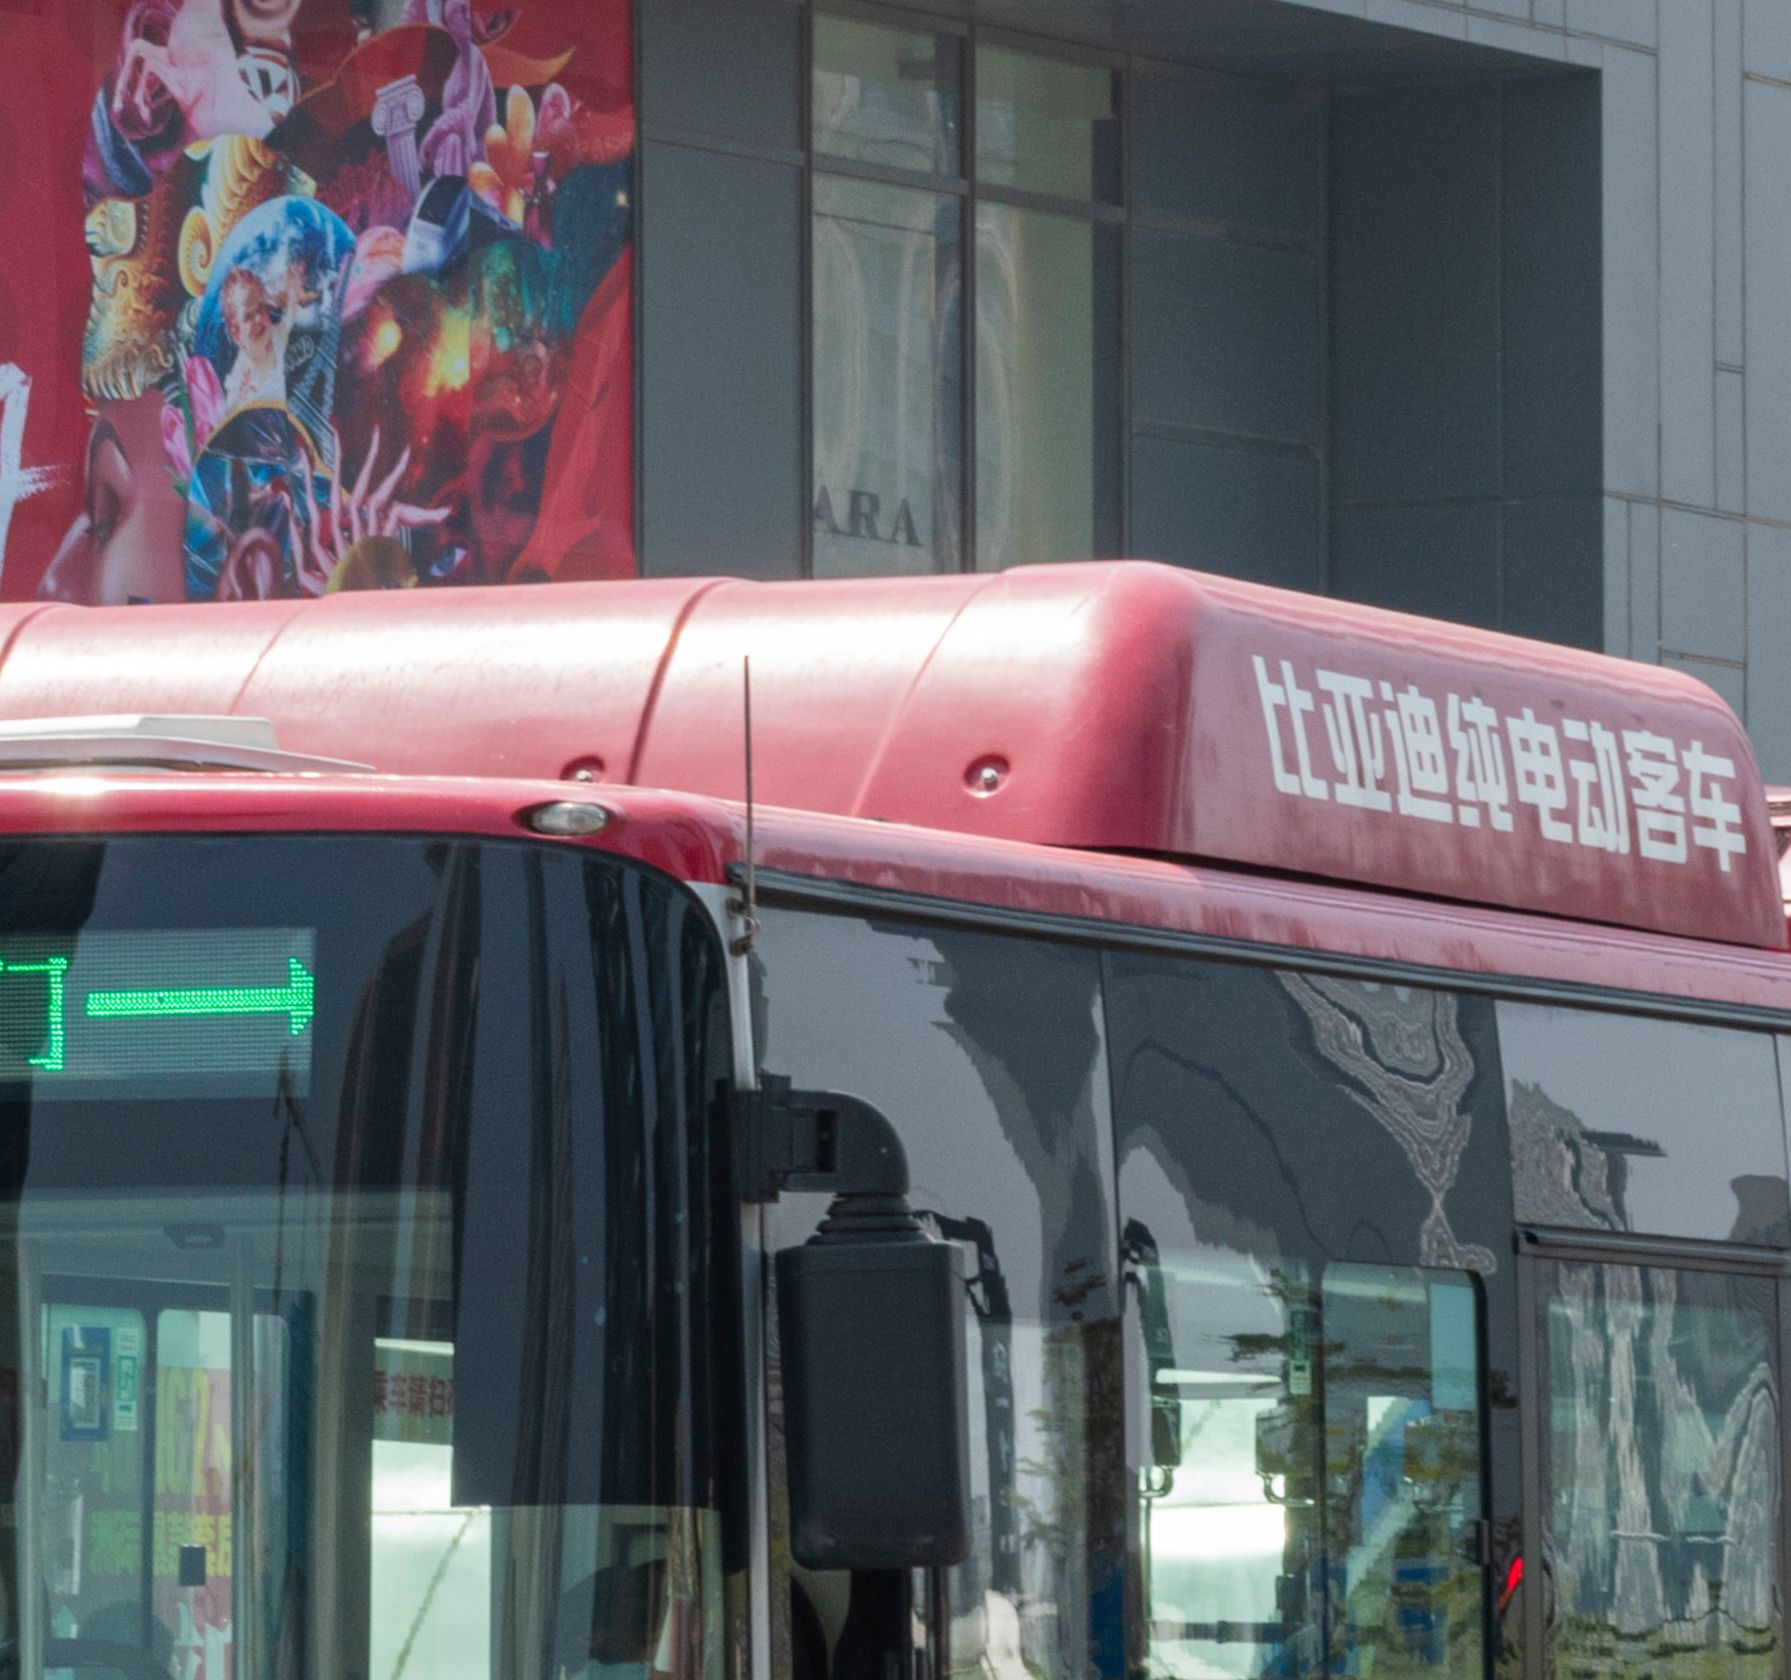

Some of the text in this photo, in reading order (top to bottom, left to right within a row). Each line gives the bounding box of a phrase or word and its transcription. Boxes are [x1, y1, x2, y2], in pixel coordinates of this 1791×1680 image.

[1252, 655, 1746, 872] 比亚迪纯电动客车
